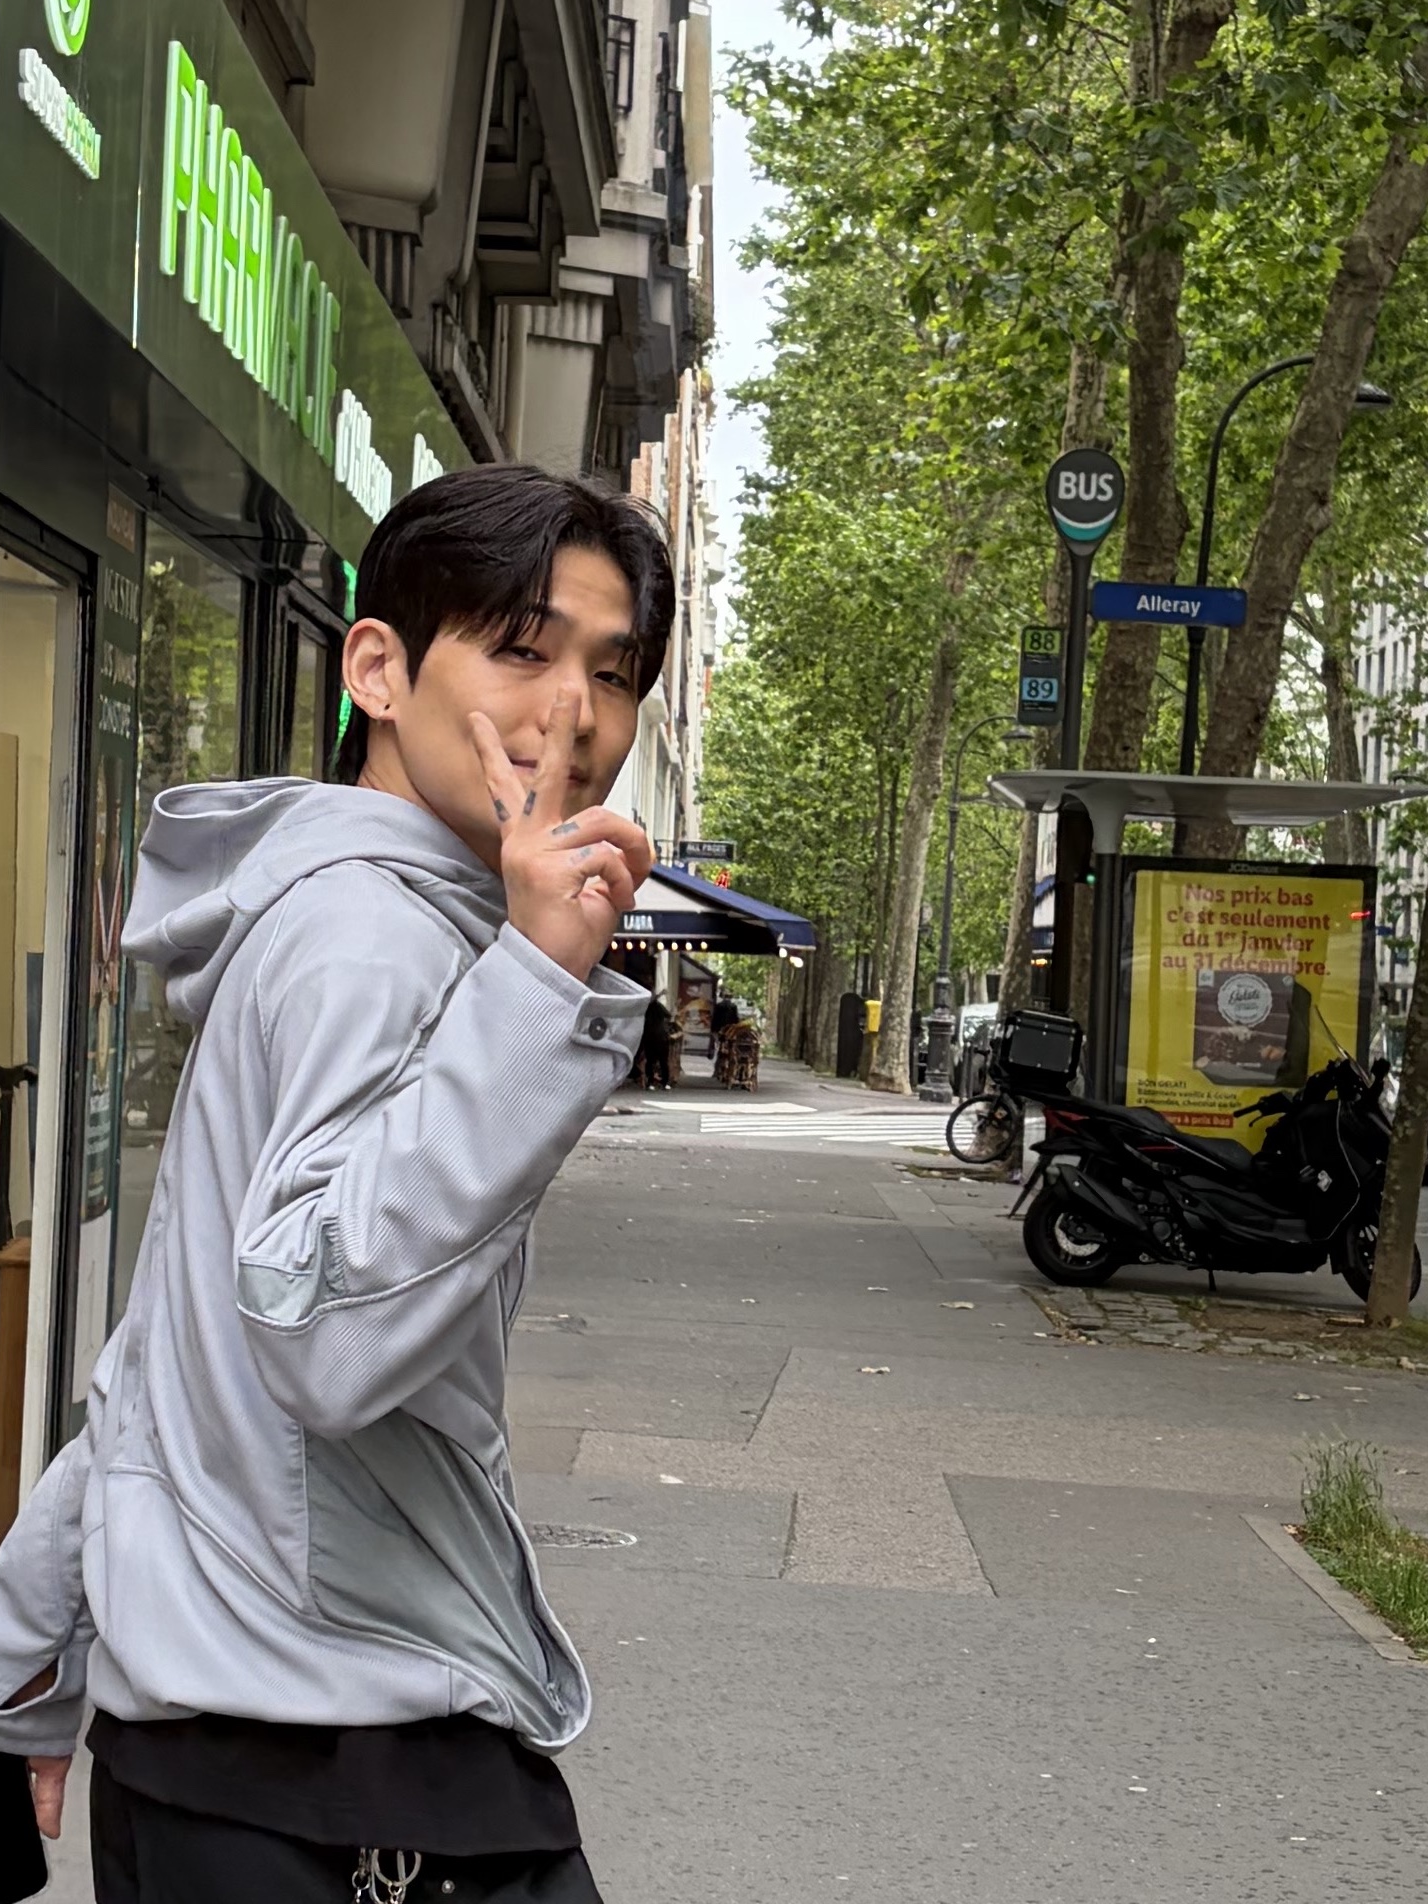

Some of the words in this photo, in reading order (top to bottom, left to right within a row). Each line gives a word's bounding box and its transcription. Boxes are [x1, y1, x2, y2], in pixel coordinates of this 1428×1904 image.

[159, 39, 340, 467] PHARMACIE
[1057, 470, 1114, 502] BUS
[1135, 594, 1202, 618] Alleray
[1029, 631, 1055, 652] 88
[1026, 680, 1054, 701] 89
[1184, 884, 1226, 902] Nos
[1231, 885, 1272, 907] prix
[1277, 887, 1314, 906] bas
[1166, 907, 1215, 926] c'est
[1219, 908, 1331, 931] seulement
[1182, 929, 1209, 948] du
[1215, 932, 1238, 948] 1er
[1240, 930, 1314, 954] janvier
[1162, 954, 1188, 970] au
[1194, 952, 1215, 970] 31
[1219, 952, 1332, 976] décembre.
